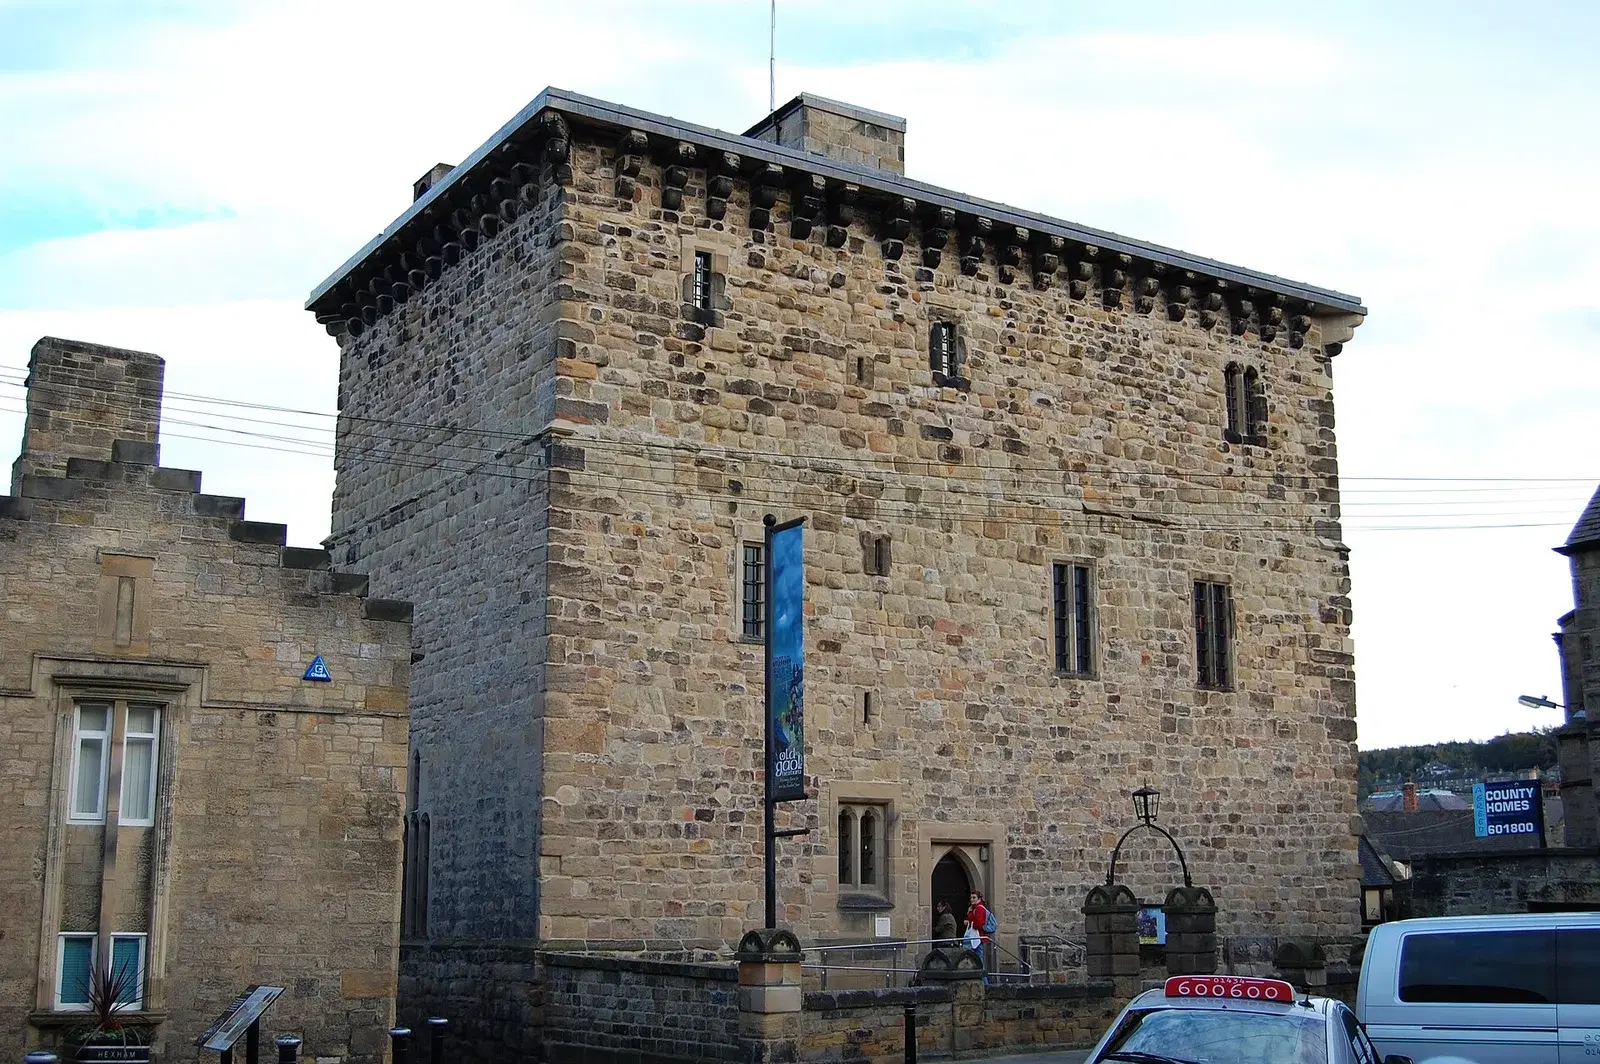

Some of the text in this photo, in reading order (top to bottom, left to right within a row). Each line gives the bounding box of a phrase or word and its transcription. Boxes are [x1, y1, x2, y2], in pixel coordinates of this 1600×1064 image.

[779, 747, 796, 760] old
[775, 754, 803, 777] gaol
[1485, 787, 1534, 801] COUNTY
[1486, 800, 1530, 813] HOMES
[1487, 822, 1534, 835] 601800
[1178, 981, 1278, 999] 600600
[97, 1050, 136, 1059] HEXHAM
